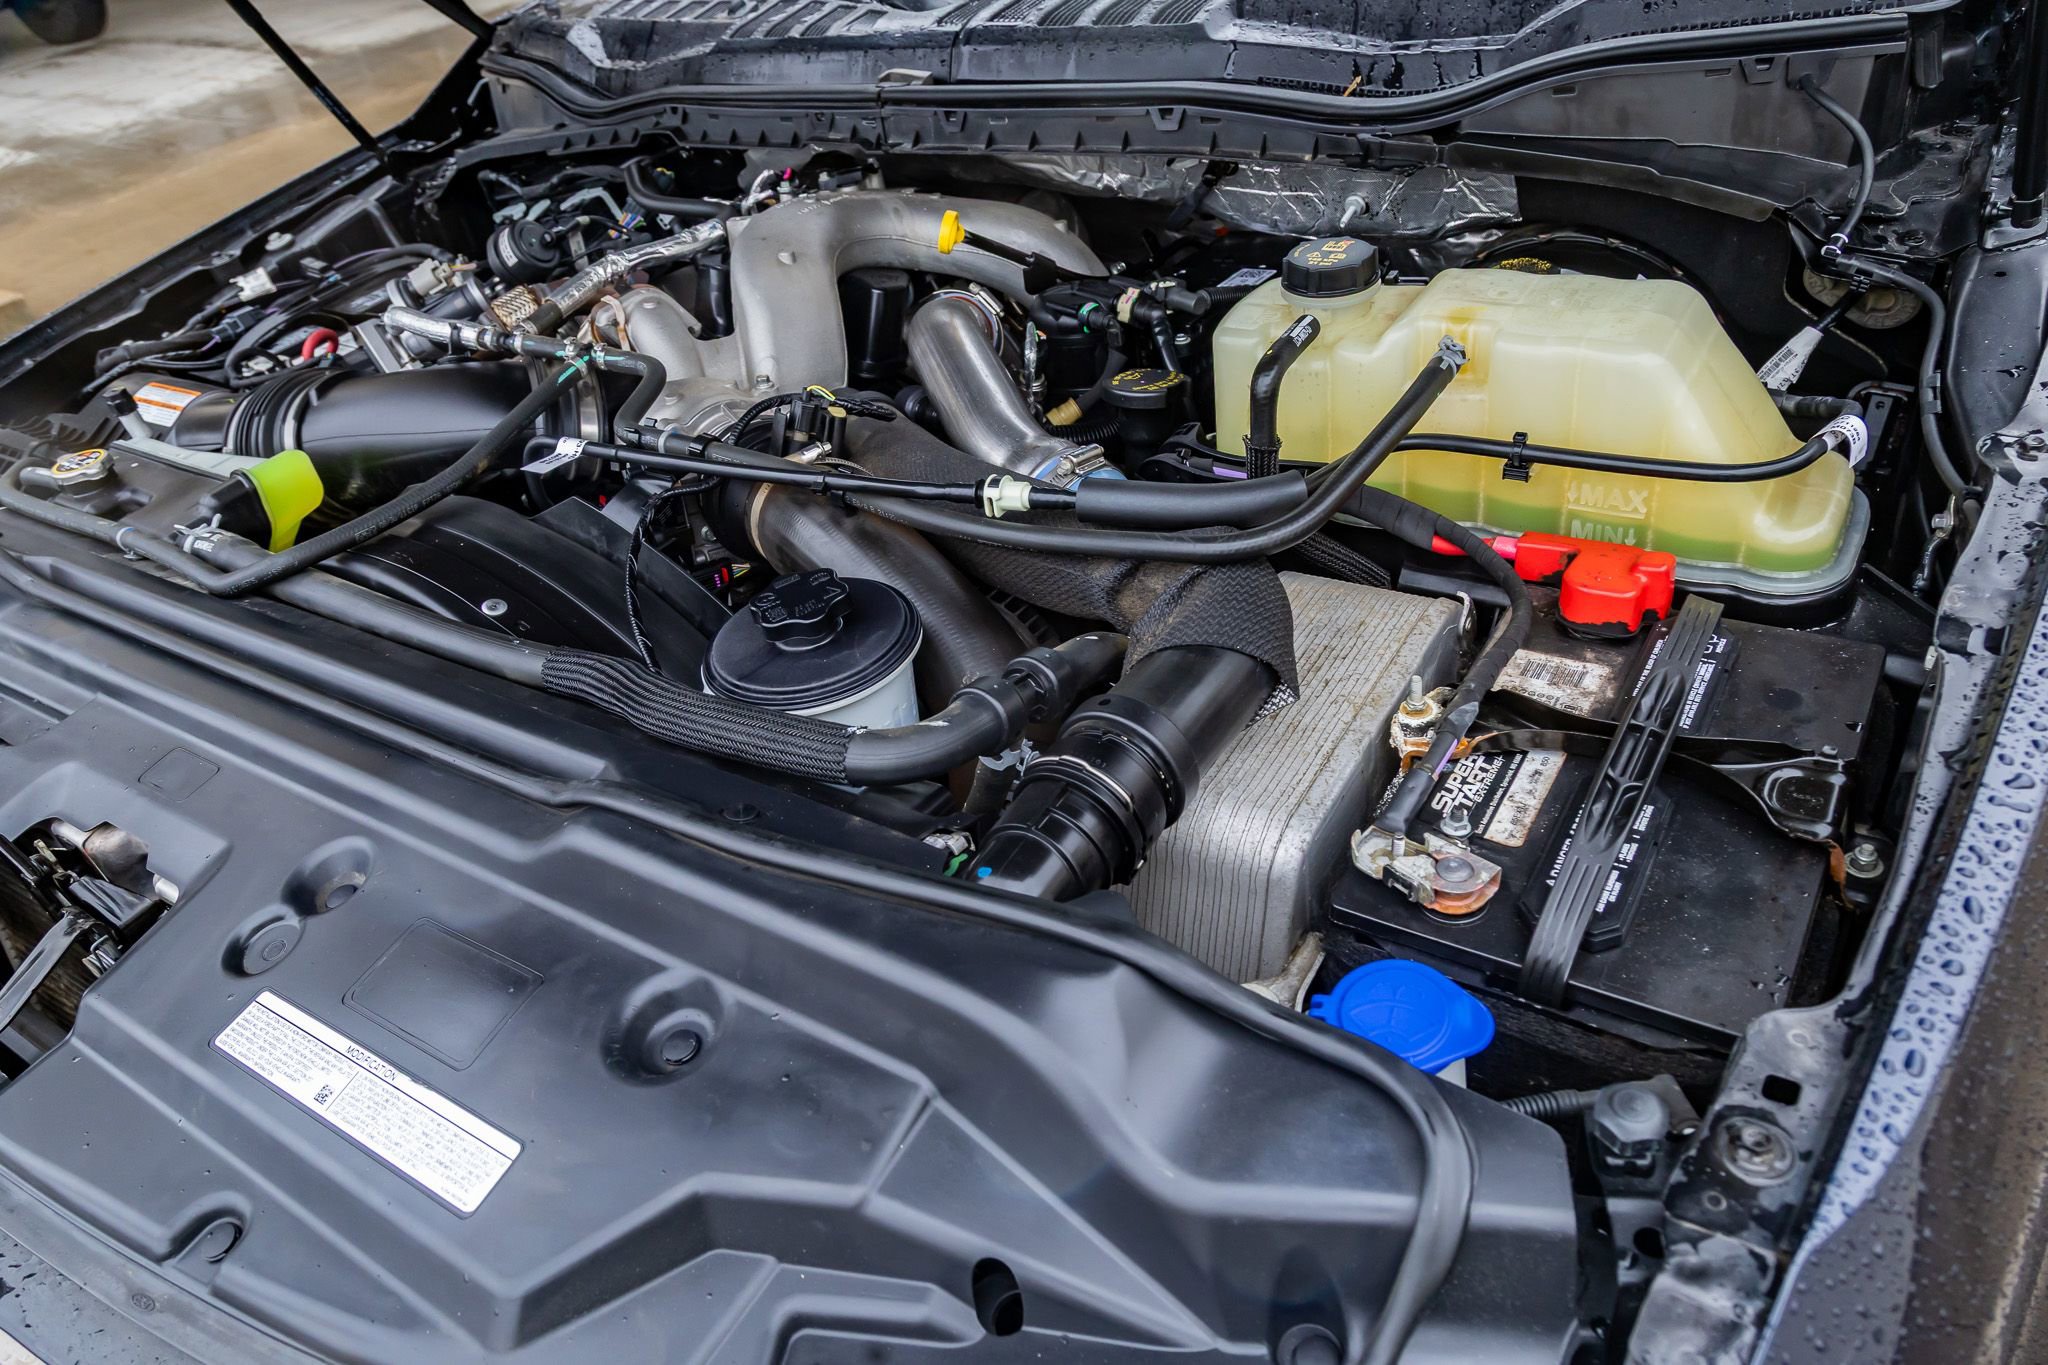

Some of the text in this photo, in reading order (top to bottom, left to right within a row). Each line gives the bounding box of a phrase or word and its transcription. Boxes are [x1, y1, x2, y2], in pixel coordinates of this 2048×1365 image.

[1580, 484, 1648, 513] MAX
[1570, 519, 1624, 545] MIN
[1431, 754, 1479, 811] SUPER
[1443, 755, 1495, 818] TART
[345, 1045, 397, 1081] MODIFICATION
